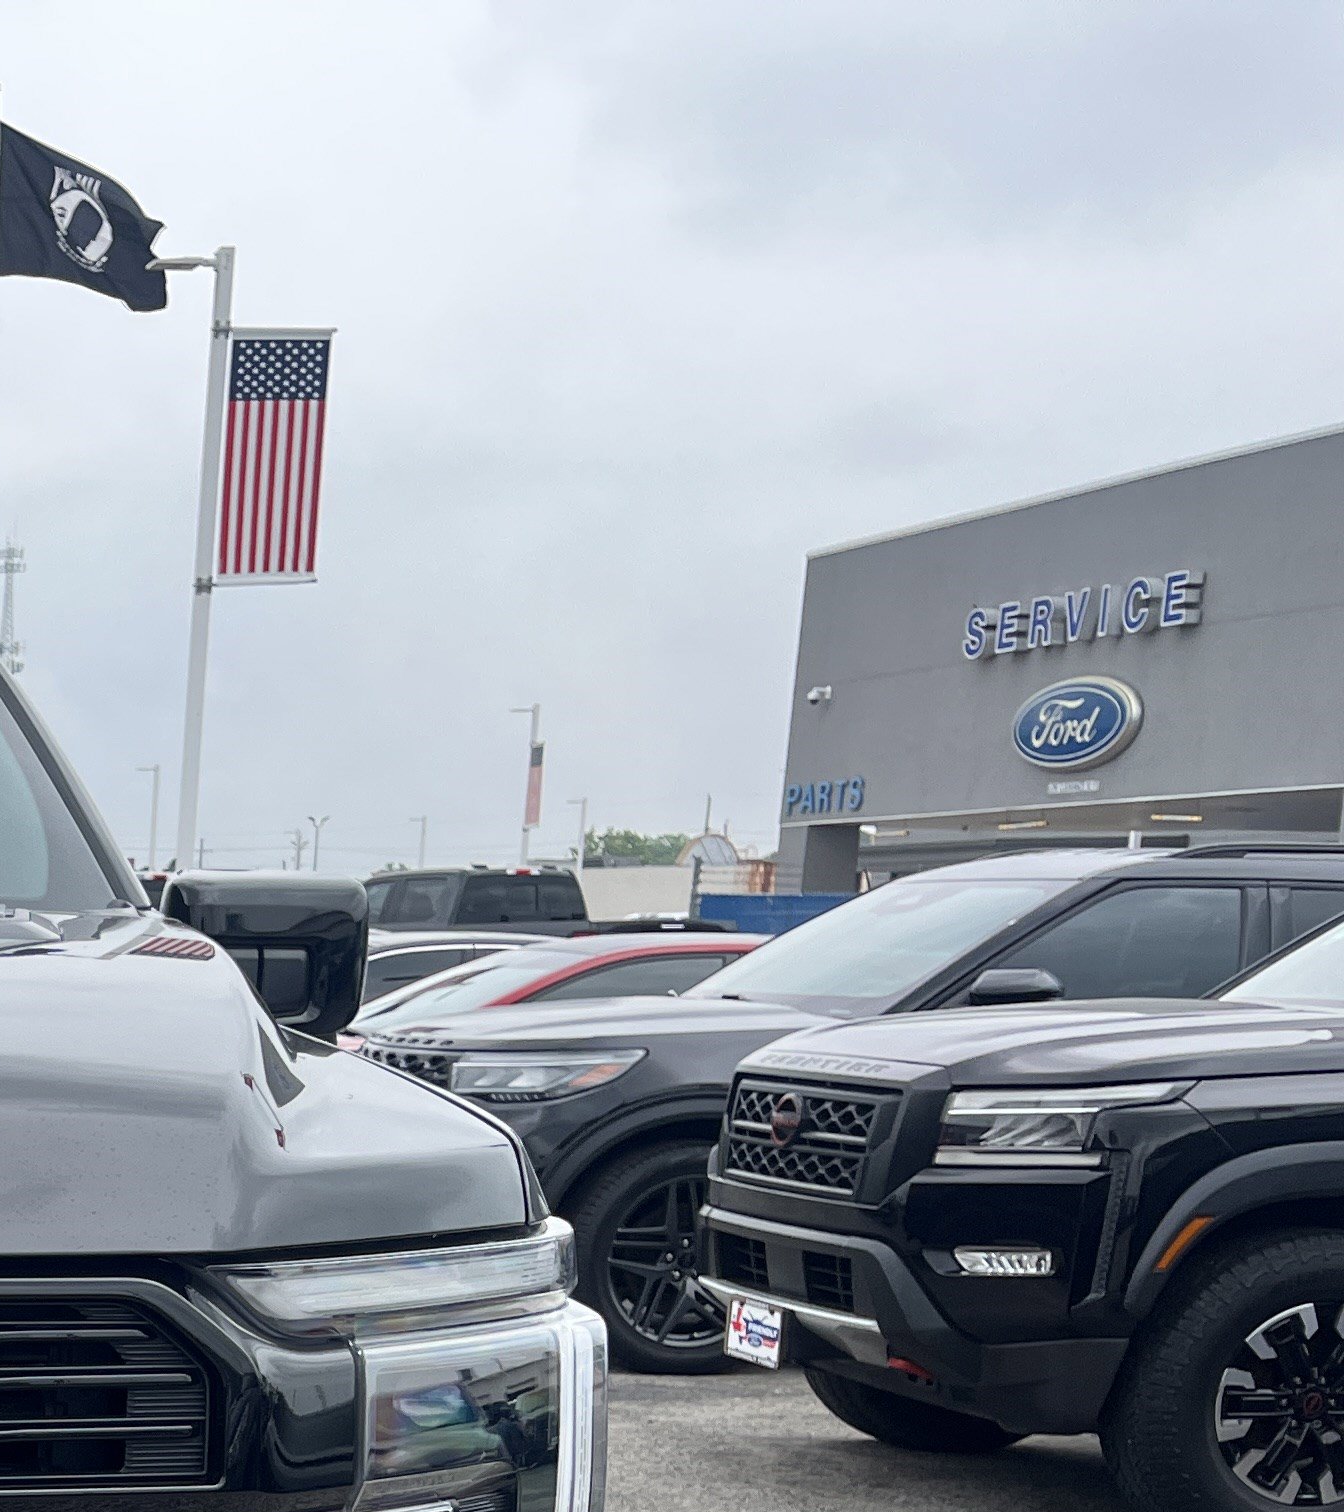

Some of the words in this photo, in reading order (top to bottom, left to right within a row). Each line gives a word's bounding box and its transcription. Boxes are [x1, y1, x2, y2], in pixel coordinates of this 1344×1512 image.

[962, 569, 1192, 660] SERVICE
[1031, 697, 1101, 748] Ford
[785, 775, 865, 817] PARTS
